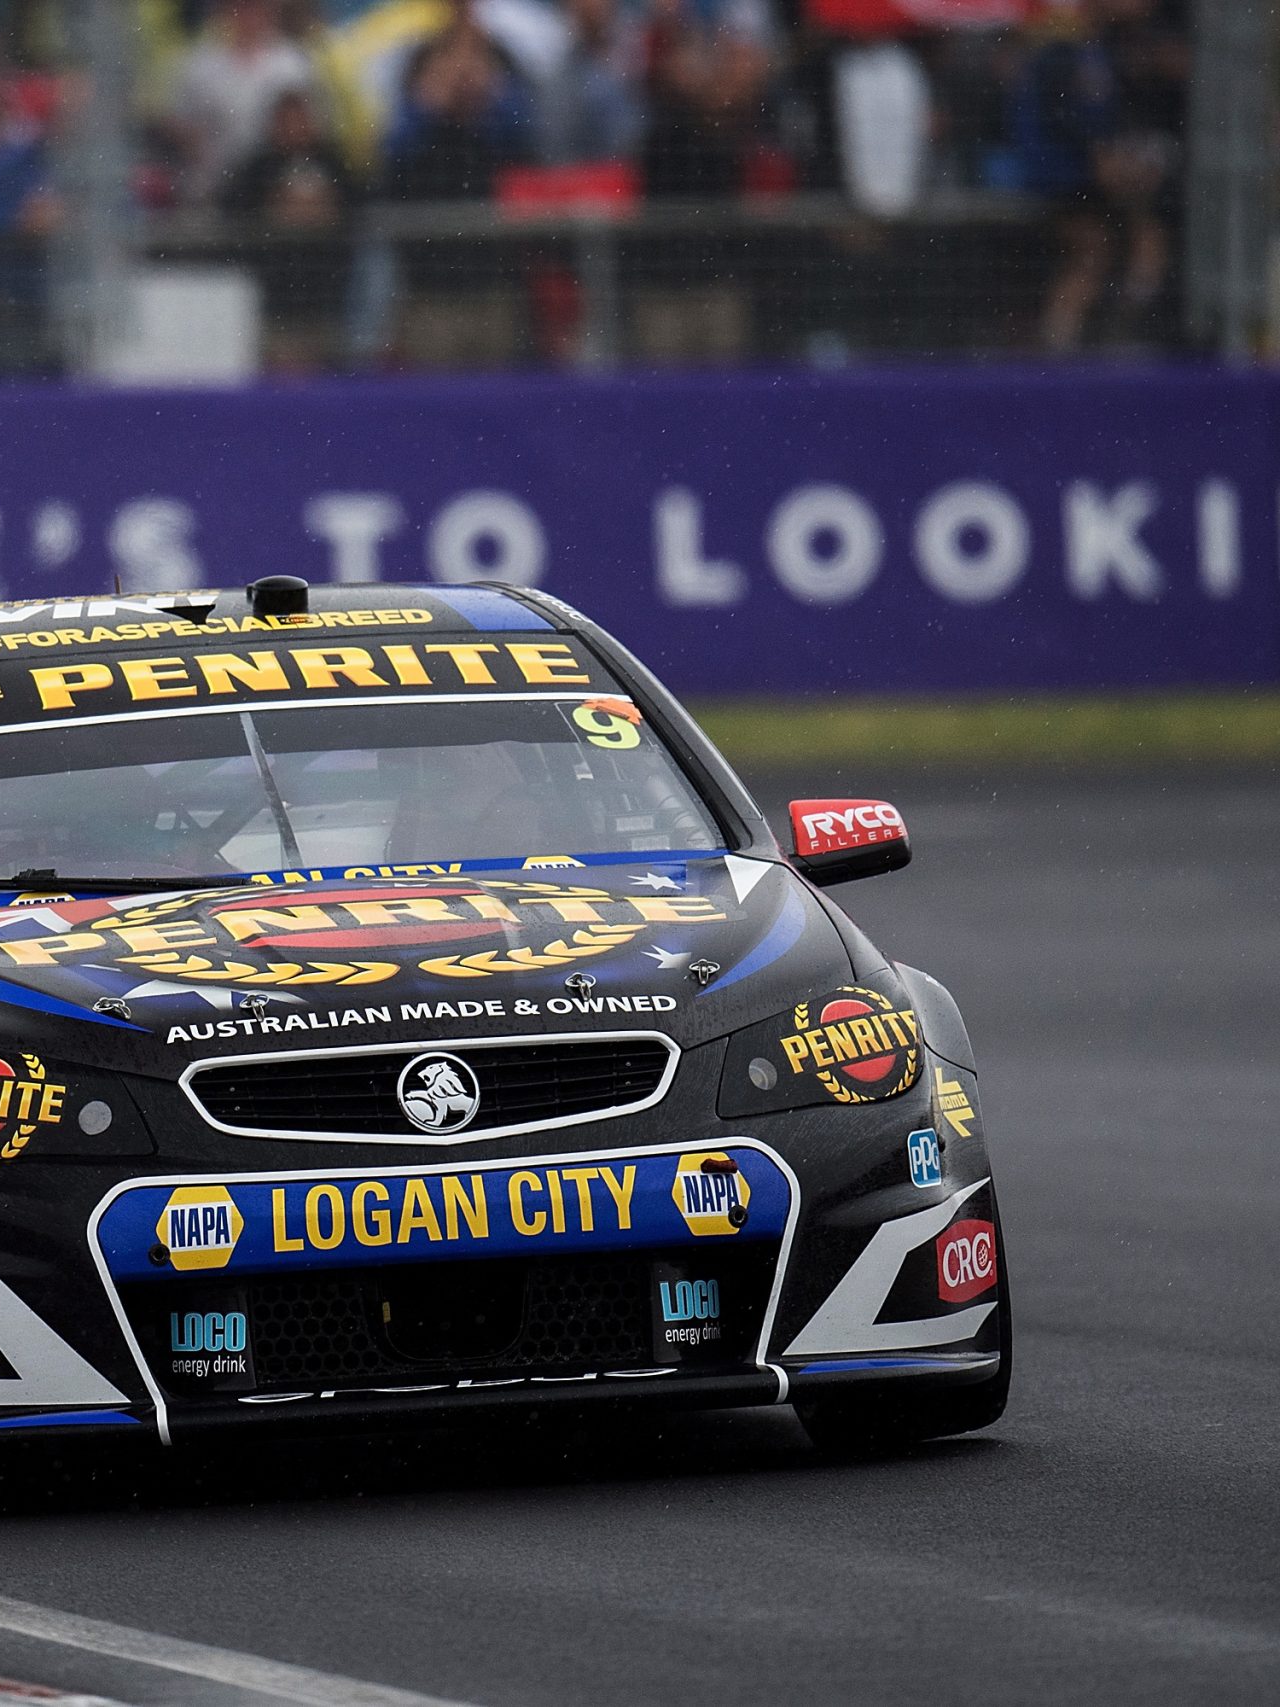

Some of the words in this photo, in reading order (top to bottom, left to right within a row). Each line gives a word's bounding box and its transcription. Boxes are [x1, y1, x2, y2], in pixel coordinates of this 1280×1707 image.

[307, 490, 549, 588] TO
[29, 643, 590, 710] PENRITE
[572, 705, 641, 750] 9
[802, 805, 900, 840] RYCO
[810, 826, 906, 850] FILTERS
[166, 1005, 392, 1044] AUSTRALIAN
[400, 1000, 508, 1021] MADE
[513, 998, 540, 1016] &
[546, 995, 677, 1016] OWNED
[912, 1137, 940, 1181] PPG
[170, 1205, 232, 1248] NAPA
[271, 1174, 490, 1253] LOGAN
[508, 1165, 637, 1236] CITY
[683, 1173, 740, 1214] NAPA
[942, 1232, 993, 1288] CRC
[660, 1280, 719, 1321] LOCO
[171, 1312, 247, 1352] LOCO
[665, 1327, 701, 1346] energy
[172, 1357, 209, 1378] energy
[213, 1355, 246, 1374] drink
